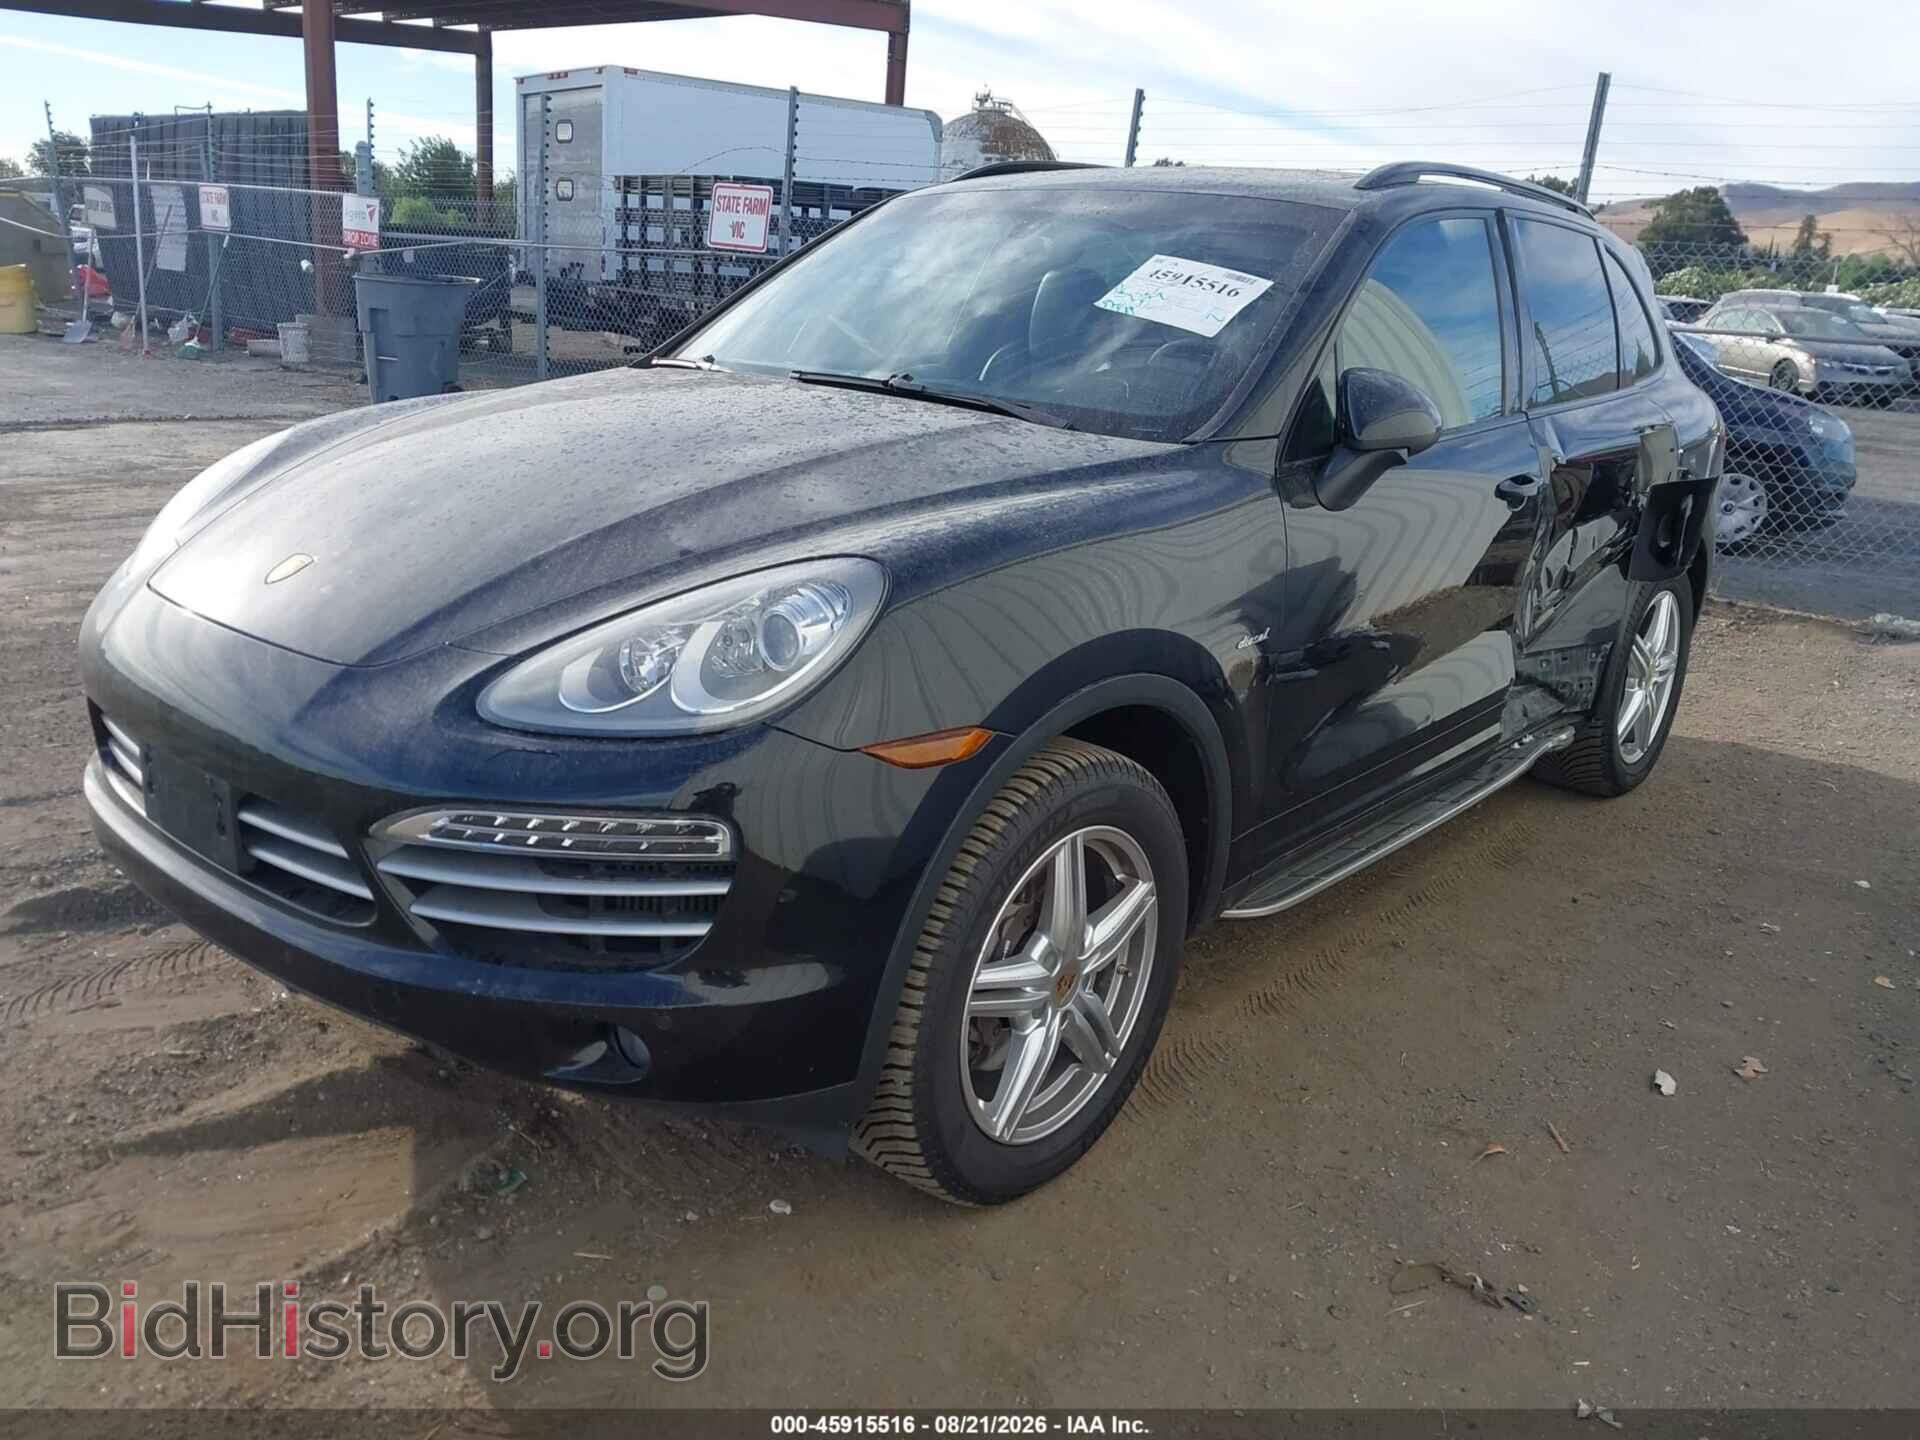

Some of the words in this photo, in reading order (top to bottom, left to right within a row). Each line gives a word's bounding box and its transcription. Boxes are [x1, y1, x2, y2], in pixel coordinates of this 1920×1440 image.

[716, 193, 742, 214] STATE
[743, 196, 768, 216] FARM
[729, 221, 745, 240] VIC
